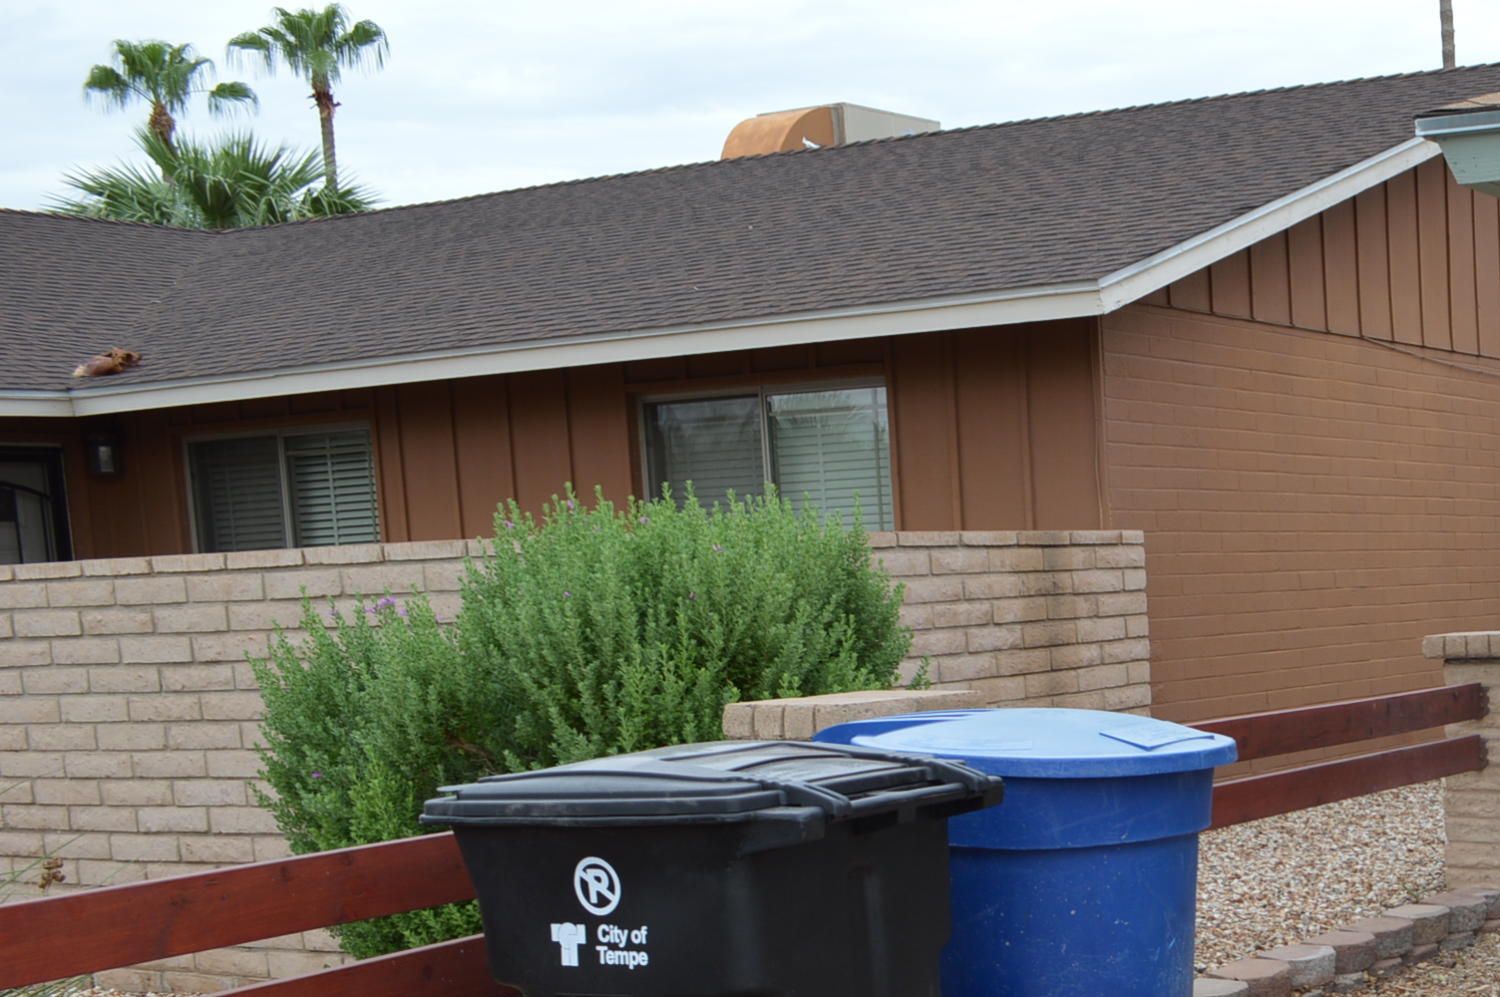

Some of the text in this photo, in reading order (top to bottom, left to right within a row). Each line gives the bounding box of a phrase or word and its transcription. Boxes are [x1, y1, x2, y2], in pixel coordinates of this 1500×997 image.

[597, 923, 648, 948] City of
[595, 945, 649, 970] Tempe
